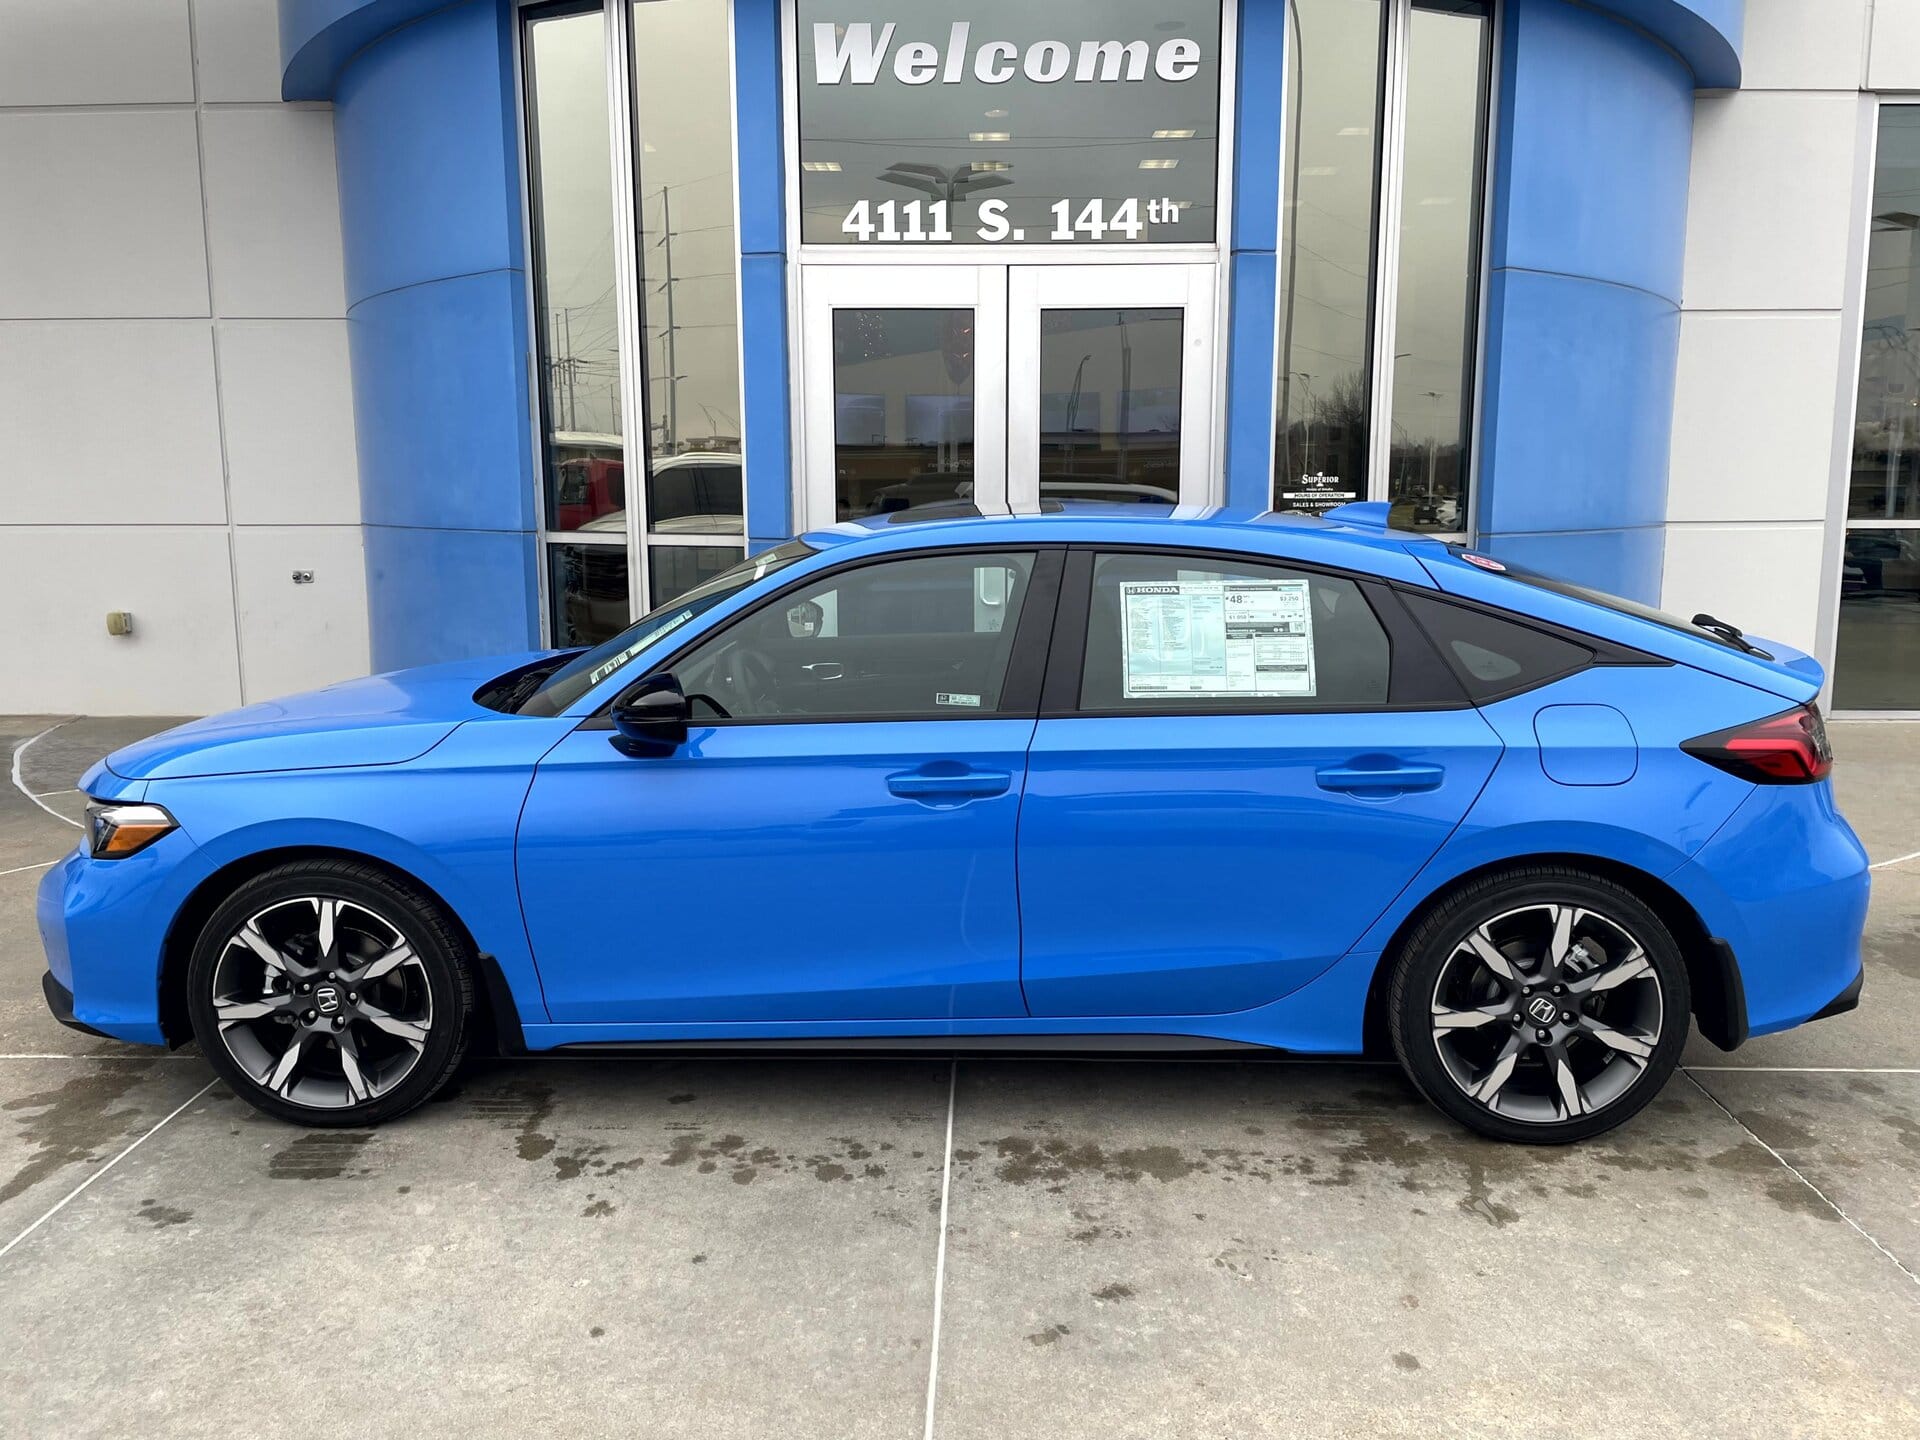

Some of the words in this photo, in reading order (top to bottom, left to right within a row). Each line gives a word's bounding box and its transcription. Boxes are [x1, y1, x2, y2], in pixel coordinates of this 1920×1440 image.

[813, 21, 1201, 85] Welcome
[842, 199, 952, 241] 4111
[976, 198, 1025, 241] S.
[1050, 197, 1180, 240] 144th
[1230, 595, 1243, 604] 48
